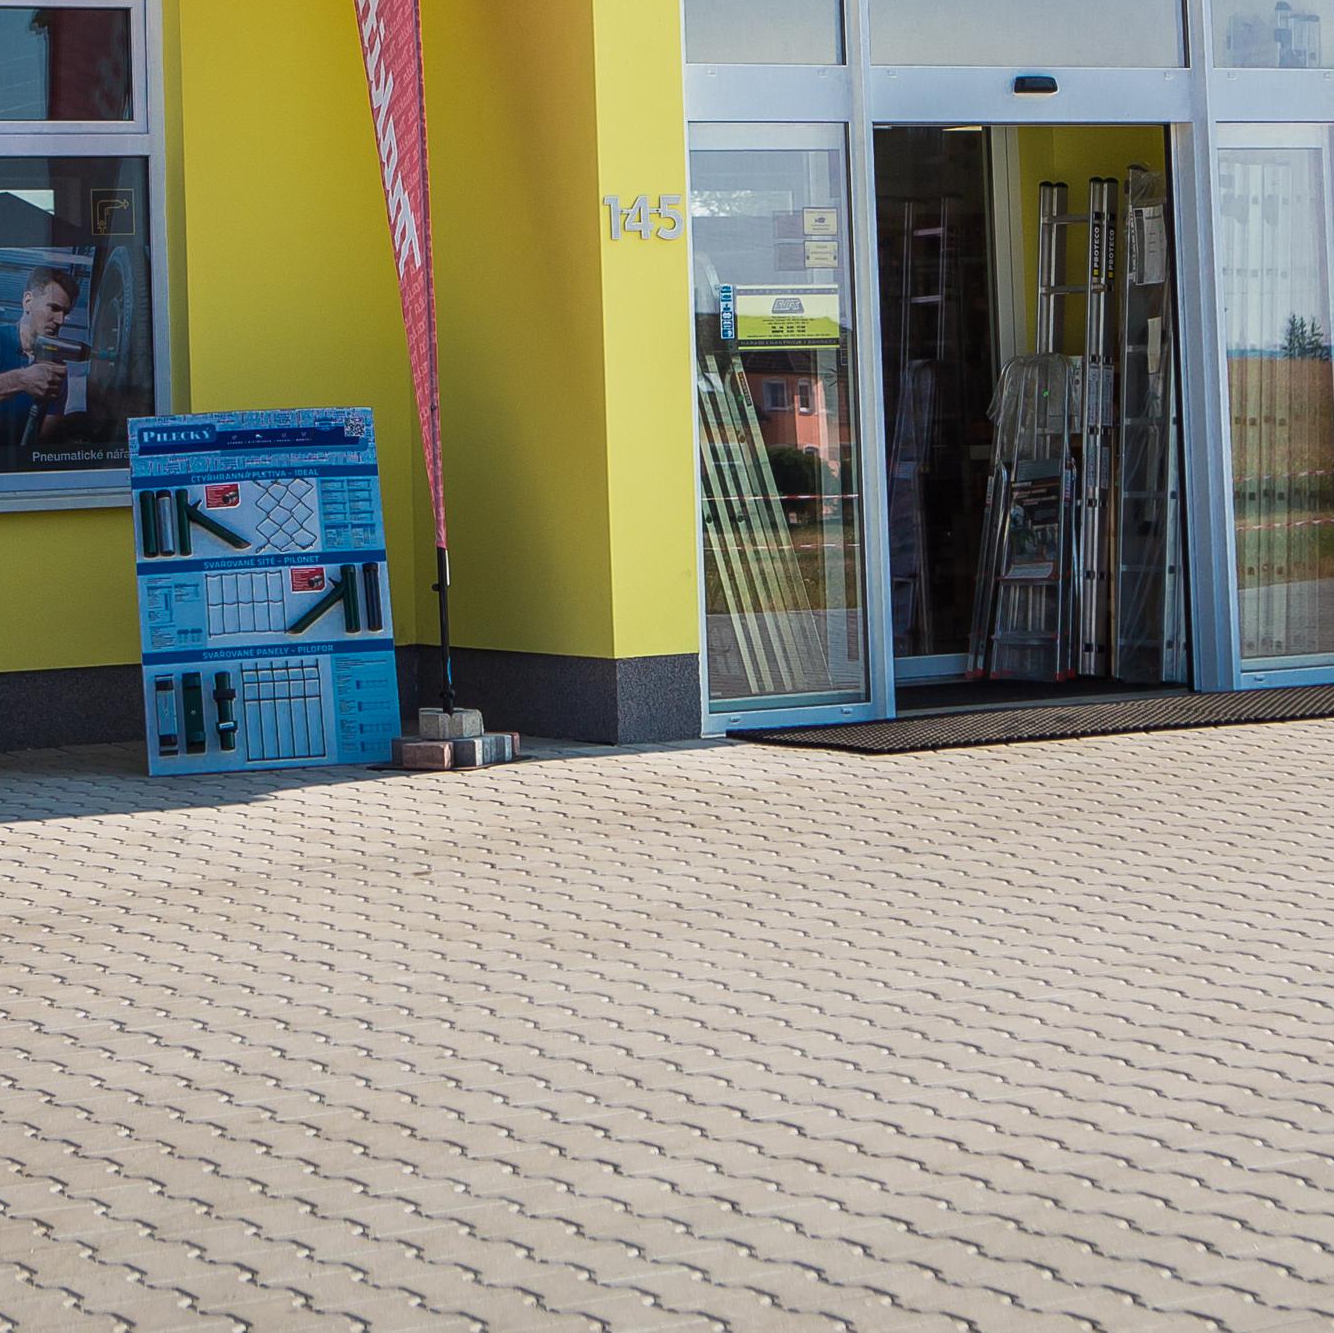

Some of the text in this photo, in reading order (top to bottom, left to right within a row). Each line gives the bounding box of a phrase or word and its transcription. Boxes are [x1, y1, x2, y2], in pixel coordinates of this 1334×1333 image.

[602, 194, 685, 241] 145
[32, 449, 104, 463] Pneumatické
[257, 647, 290, 657] PANELY
